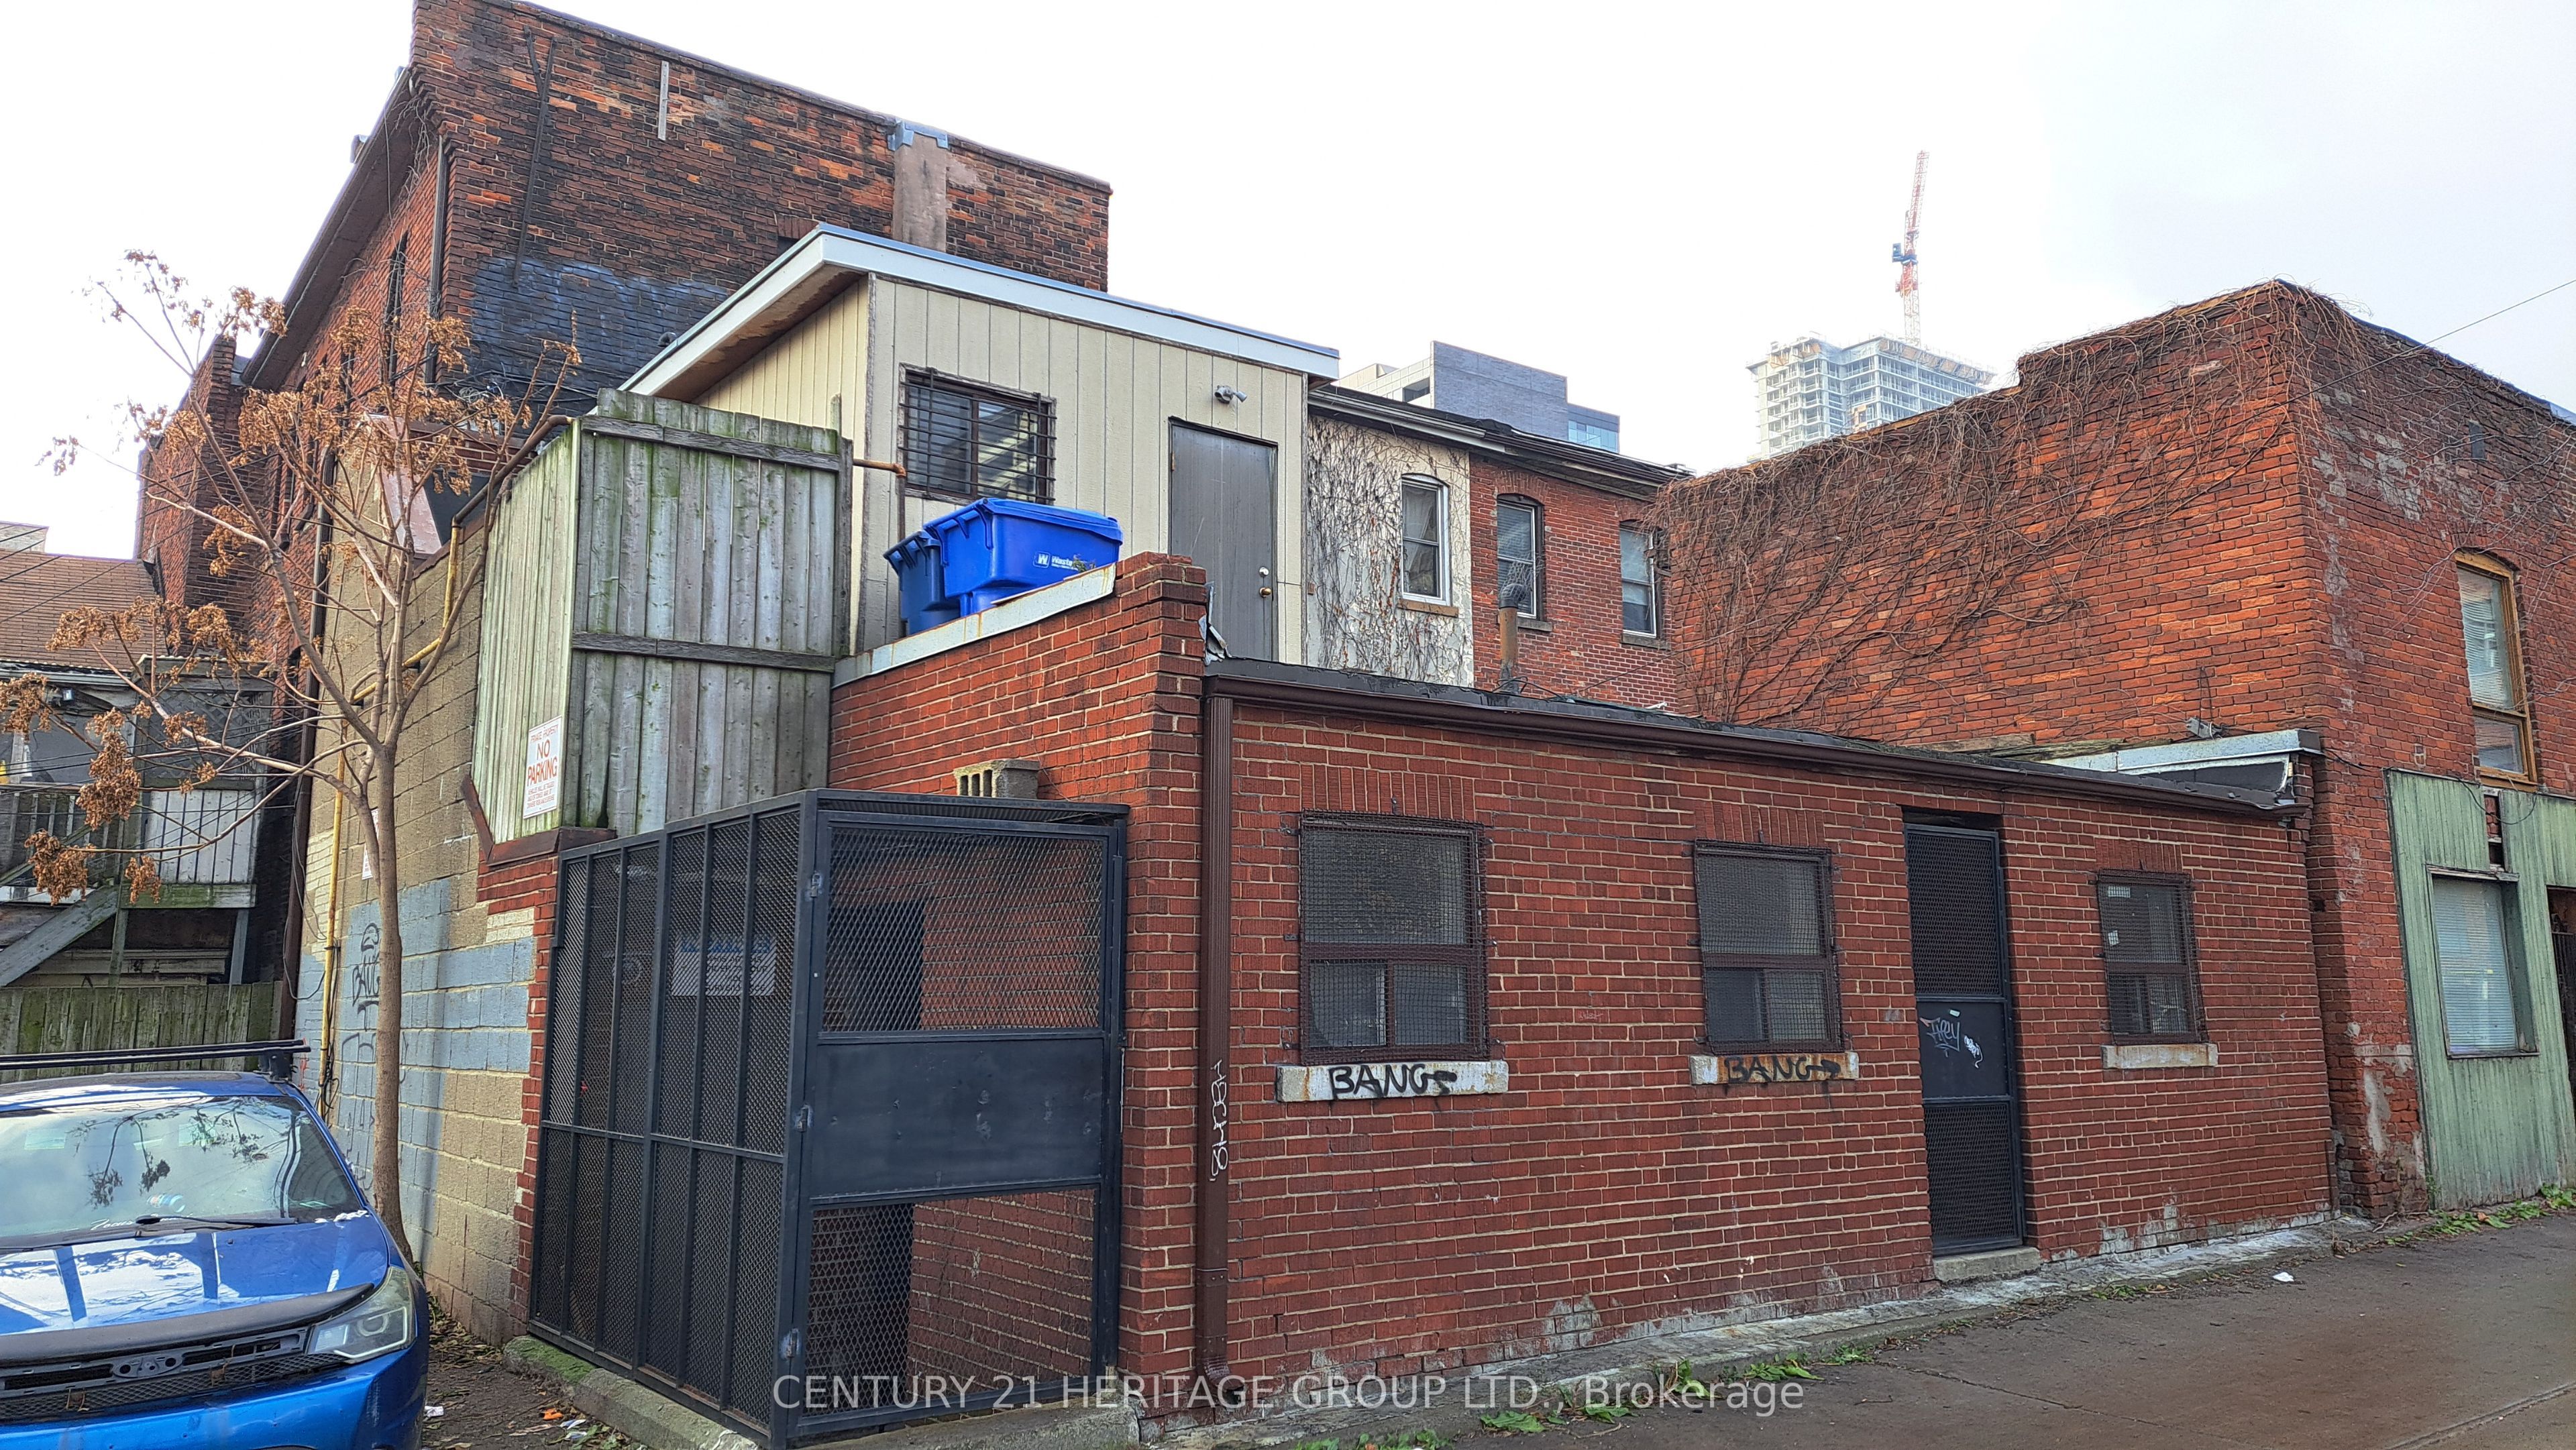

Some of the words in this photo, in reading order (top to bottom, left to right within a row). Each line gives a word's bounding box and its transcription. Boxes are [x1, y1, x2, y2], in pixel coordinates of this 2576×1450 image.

[536, 738, 551, 761] NO
[527, 756, 557, 787] PARKING
[1328, 1064, 1429, 1100] BANG
[1724, 1056, 1810, 1083] BANG
